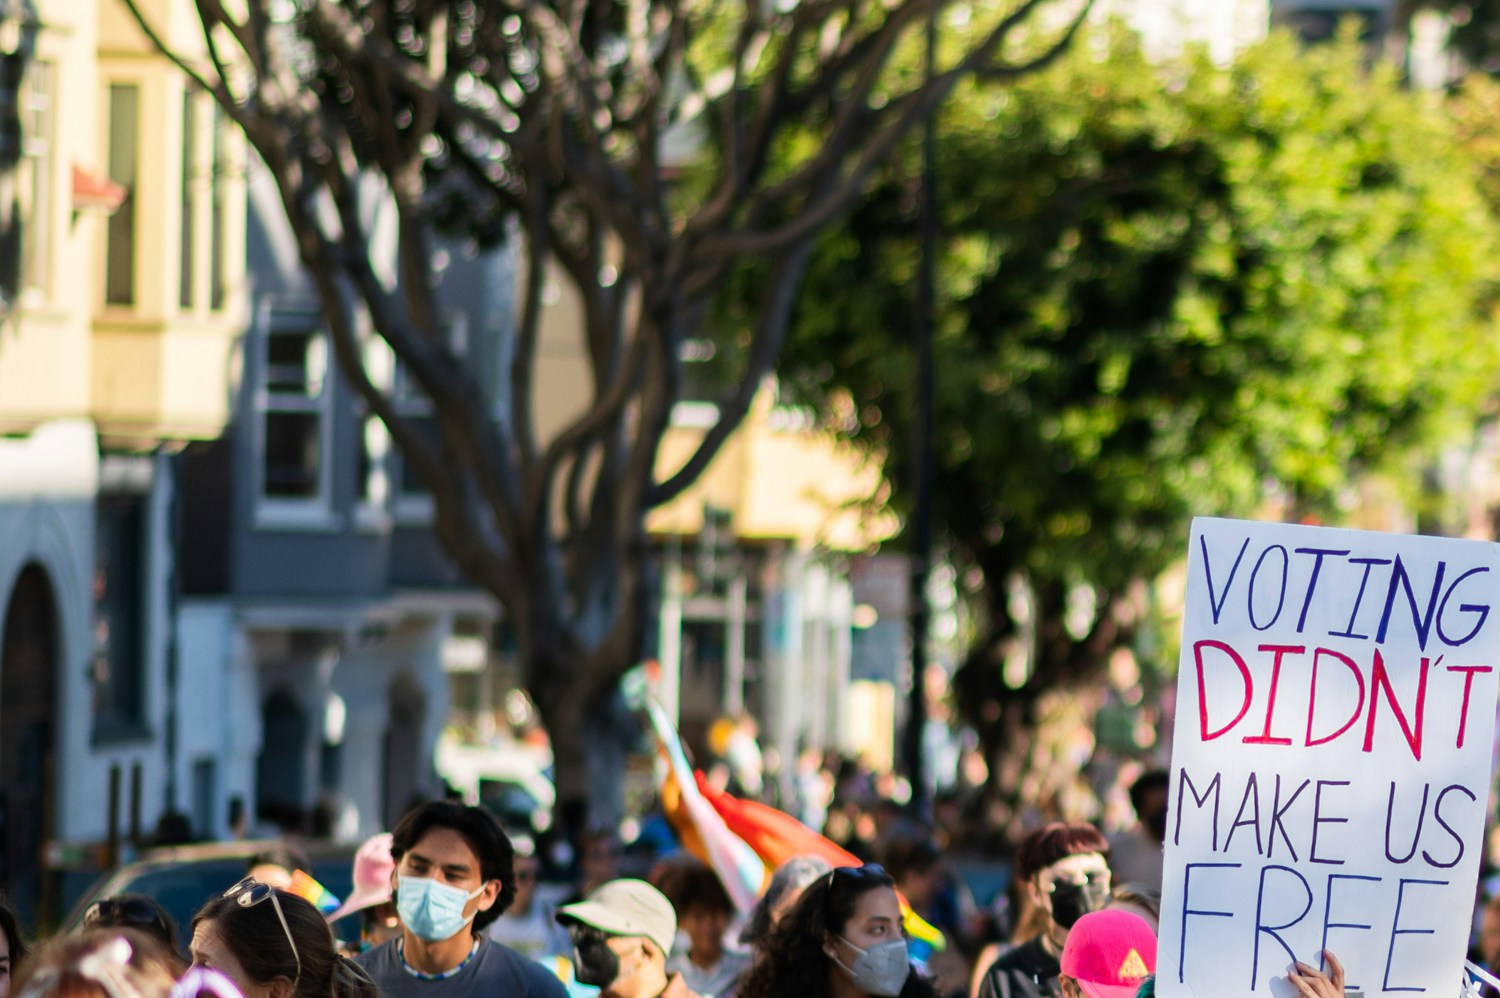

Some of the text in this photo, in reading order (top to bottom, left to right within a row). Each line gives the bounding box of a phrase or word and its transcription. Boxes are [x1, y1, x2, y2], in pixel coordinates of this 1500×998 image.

[1200, 534, 1490, 652] VOTING
[1193, 639, 1493, 762] DIDN'T
[1174, 767, 1477, 869] MAKE US
[1179, 862, 1450, 993] FREE
